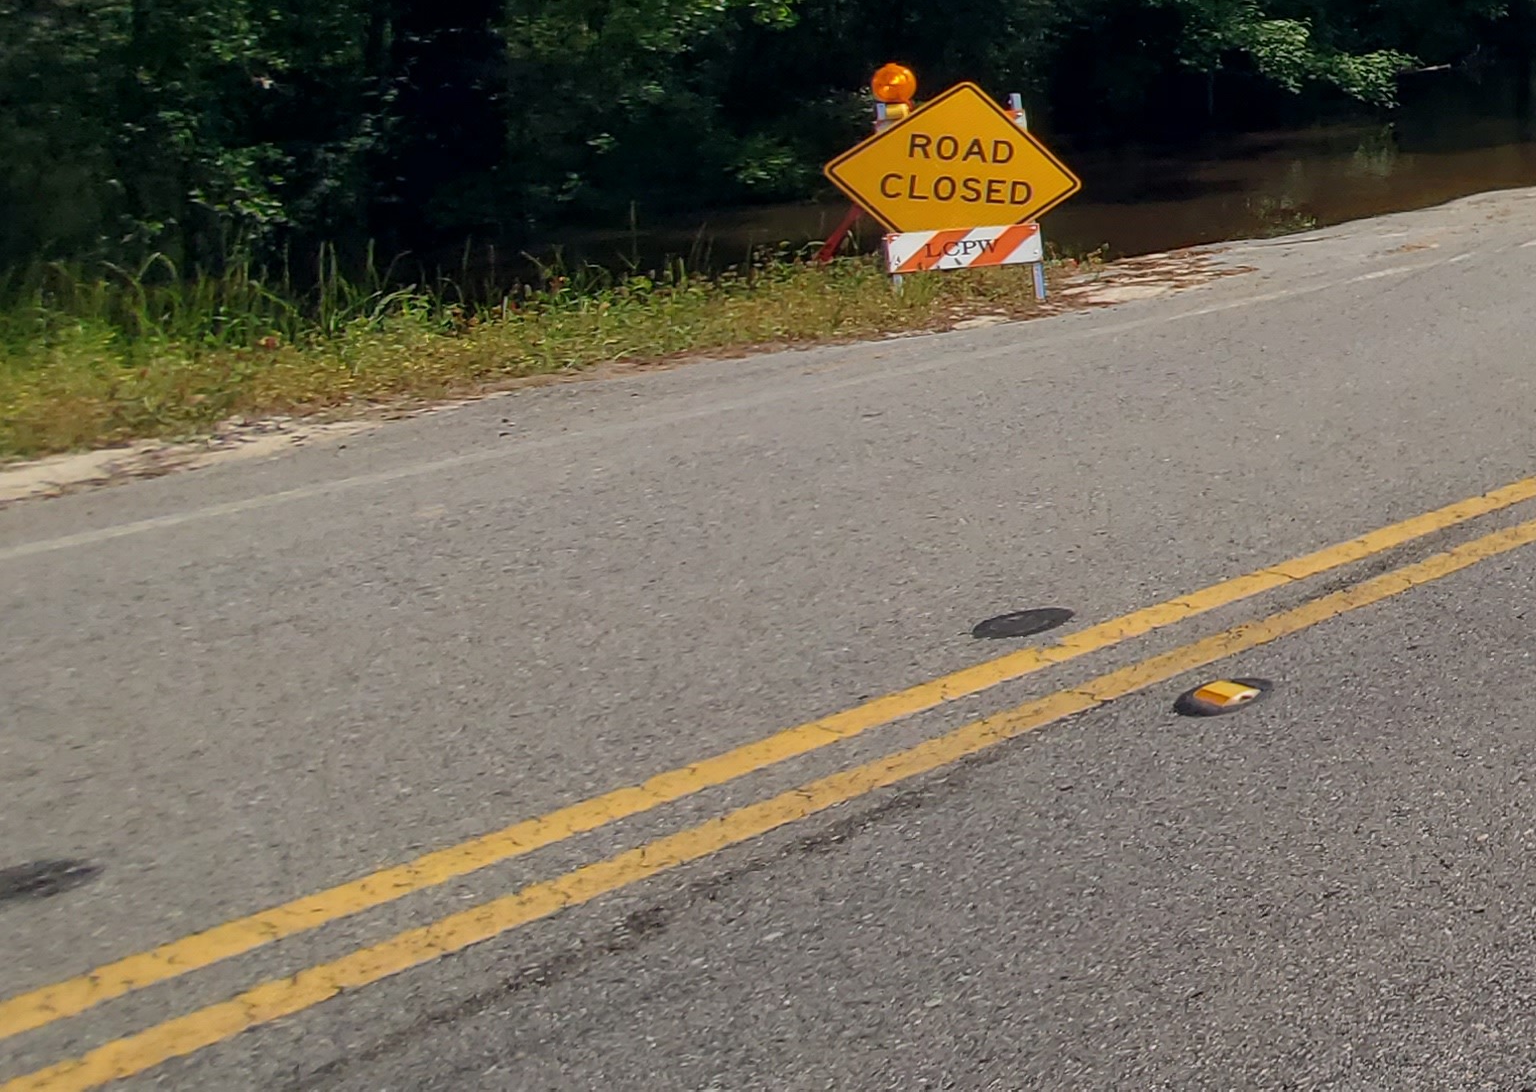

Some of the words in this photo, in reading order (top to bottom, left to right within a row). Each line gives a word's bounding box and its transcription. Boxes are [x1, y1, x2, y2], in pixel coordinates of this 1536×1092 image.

[908, 133, 1014, 164] ROAD
[880, 173, 1032, 205] CLOSED
[924, 239, 999, 258] LCPW
